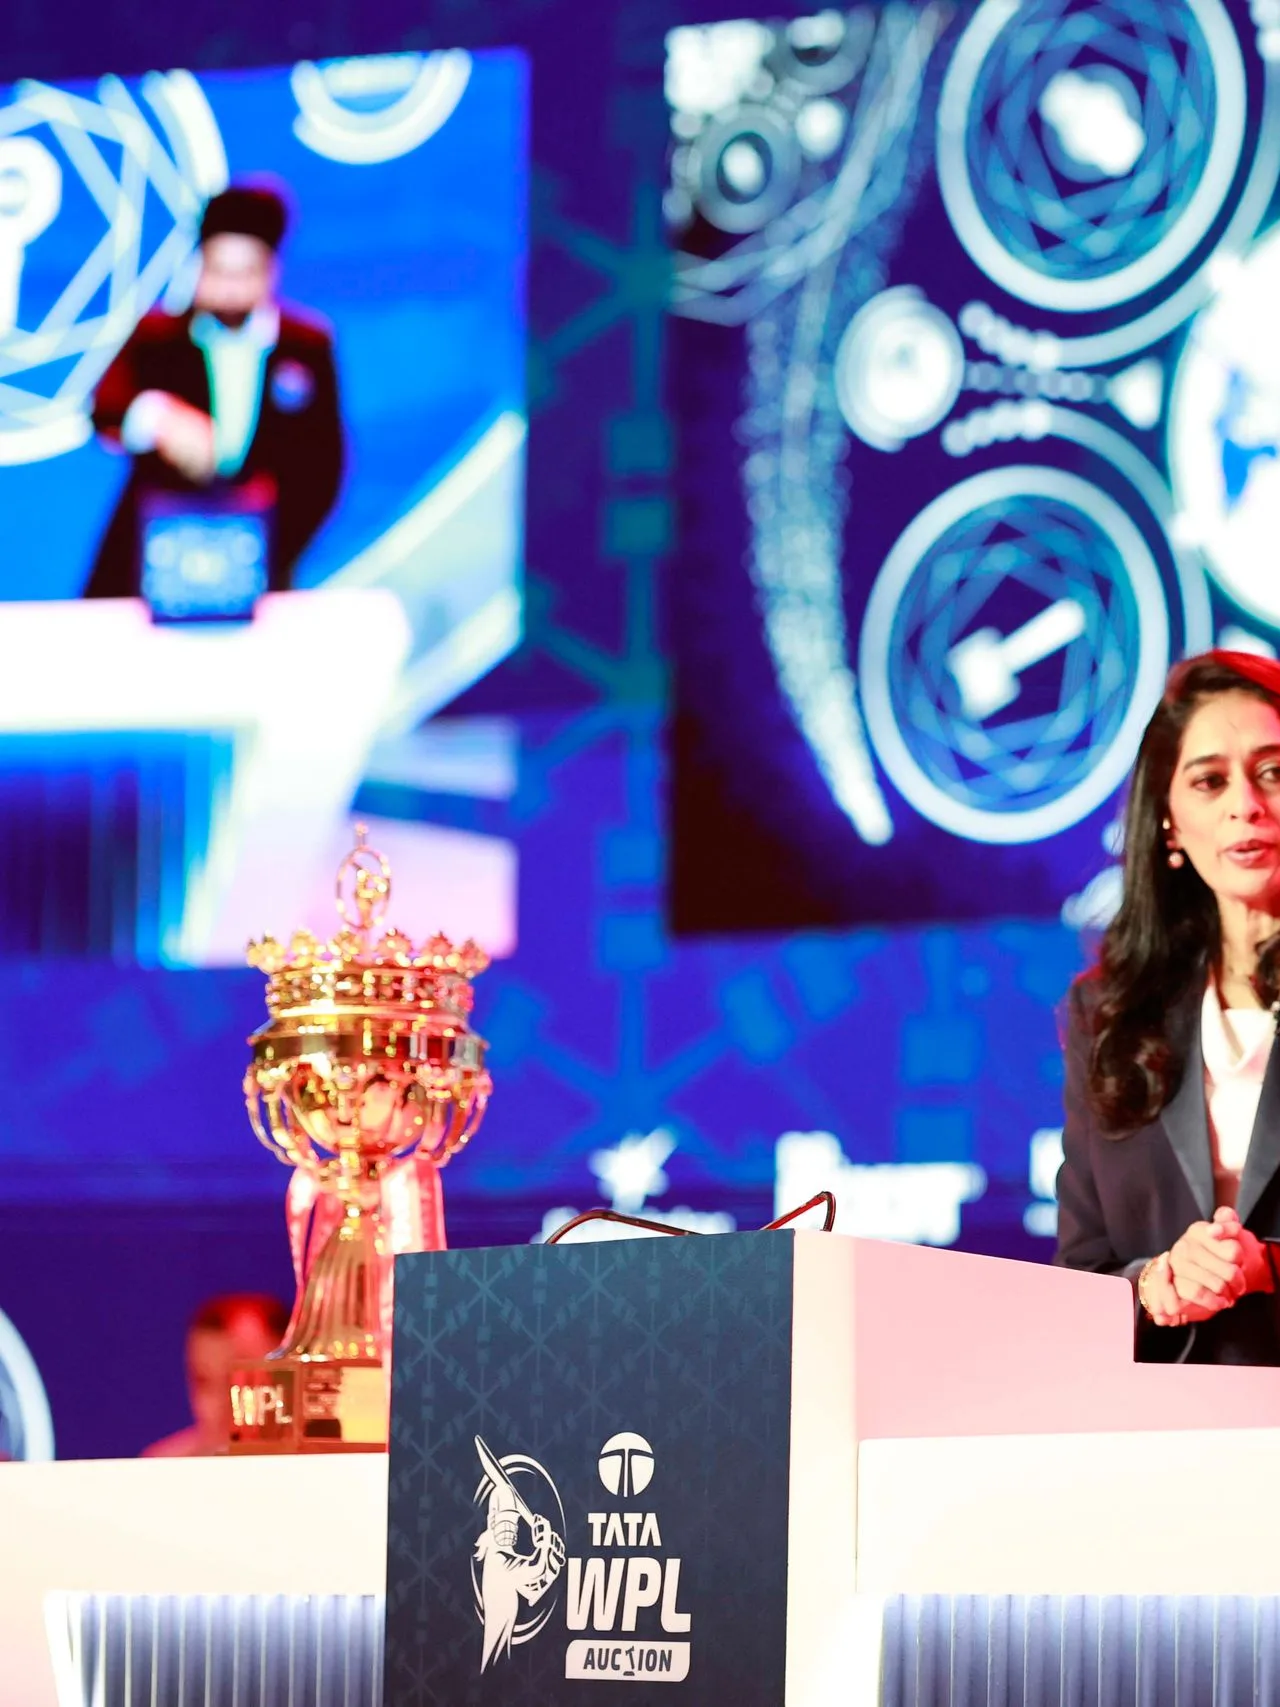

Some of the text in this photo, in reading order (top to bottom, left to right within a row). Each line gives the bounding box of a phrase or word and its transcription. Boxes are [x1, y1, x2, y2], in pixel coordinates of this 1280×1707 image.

[230, 1385, 292, 1426] WPL
[588, 1513, 662, 1546] TATA
[566, 1557, 691, 1633] WPL
[583, 1646, 672, 1676] AUCTION
